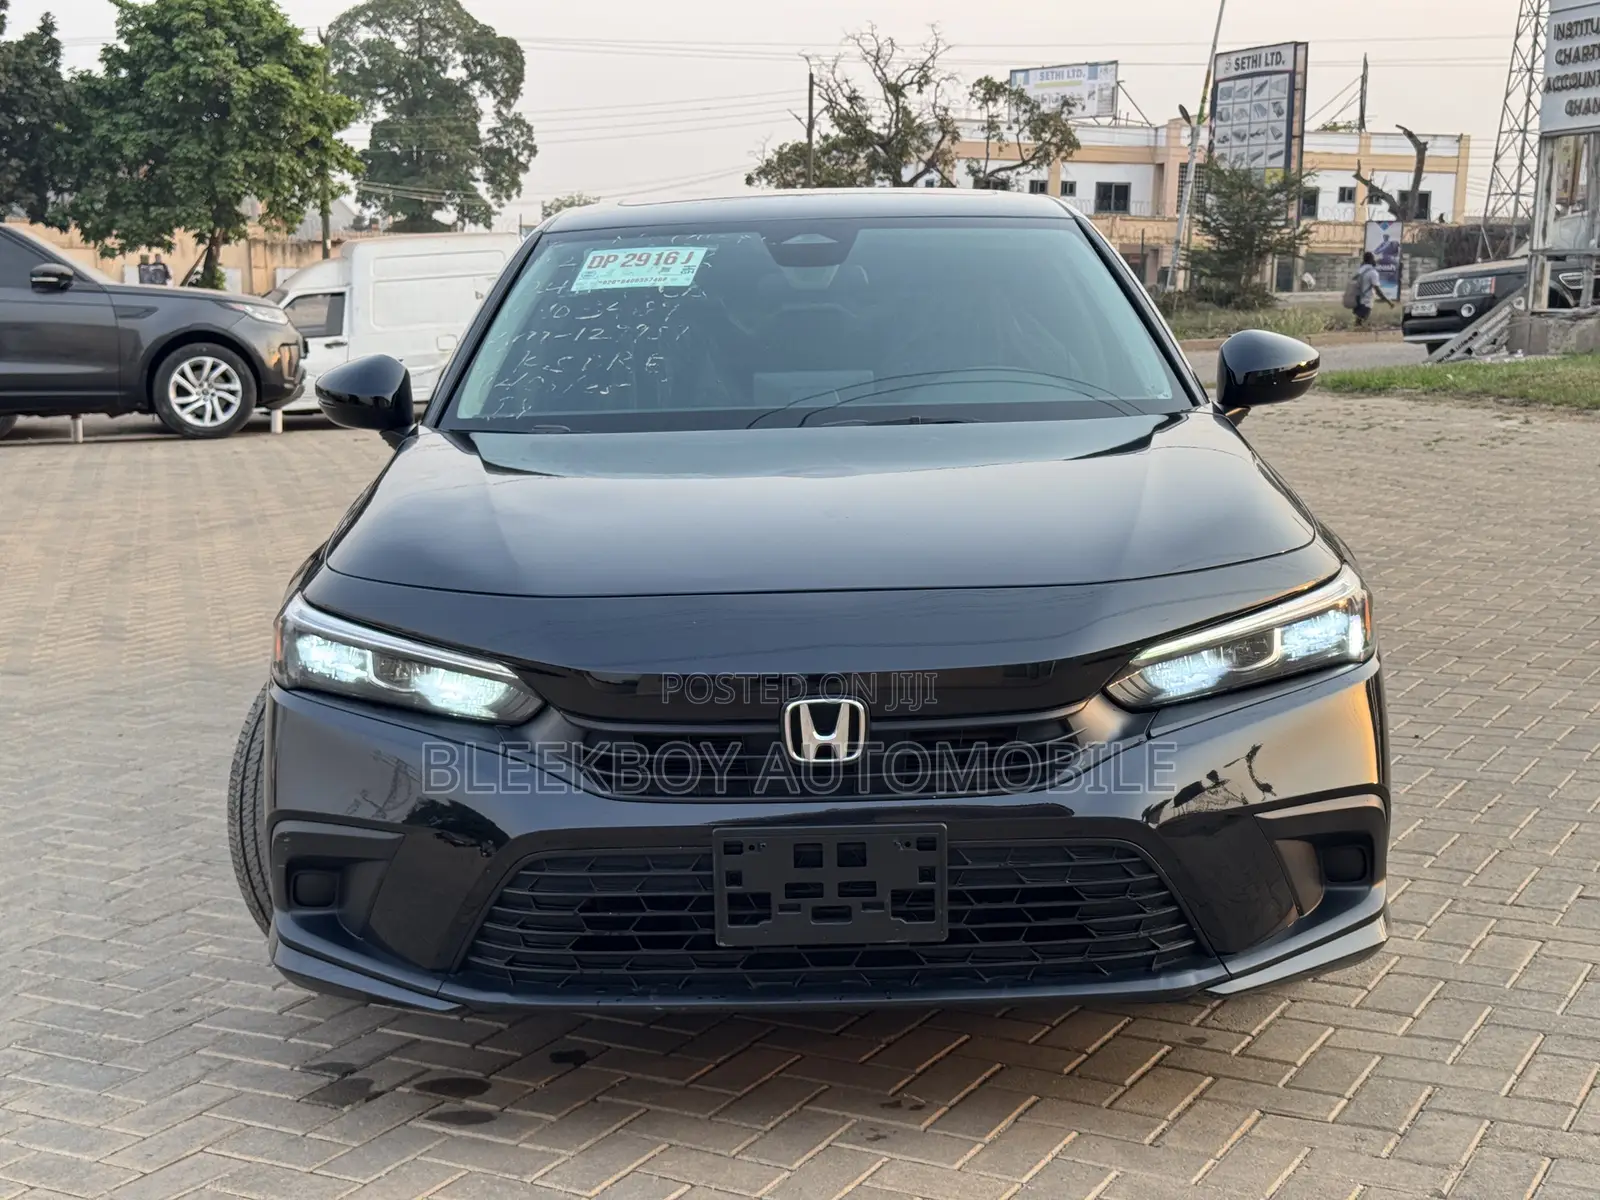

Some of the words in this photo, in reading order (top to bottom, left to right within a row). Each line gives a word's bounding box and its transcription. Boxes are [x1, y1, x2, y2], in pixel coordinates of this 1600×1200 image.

[1554, 17, 1600, 41] INSTITU
[1234, 54, 1262, 71] SETHI
[1264, 51, 1286, 67] LTD.
[1039, 69, 1065, 81] SETHI
[587, 254, 619, 270] DP
[620, 251, 681, 268] 2916
[681, 251, 695, 265] J
